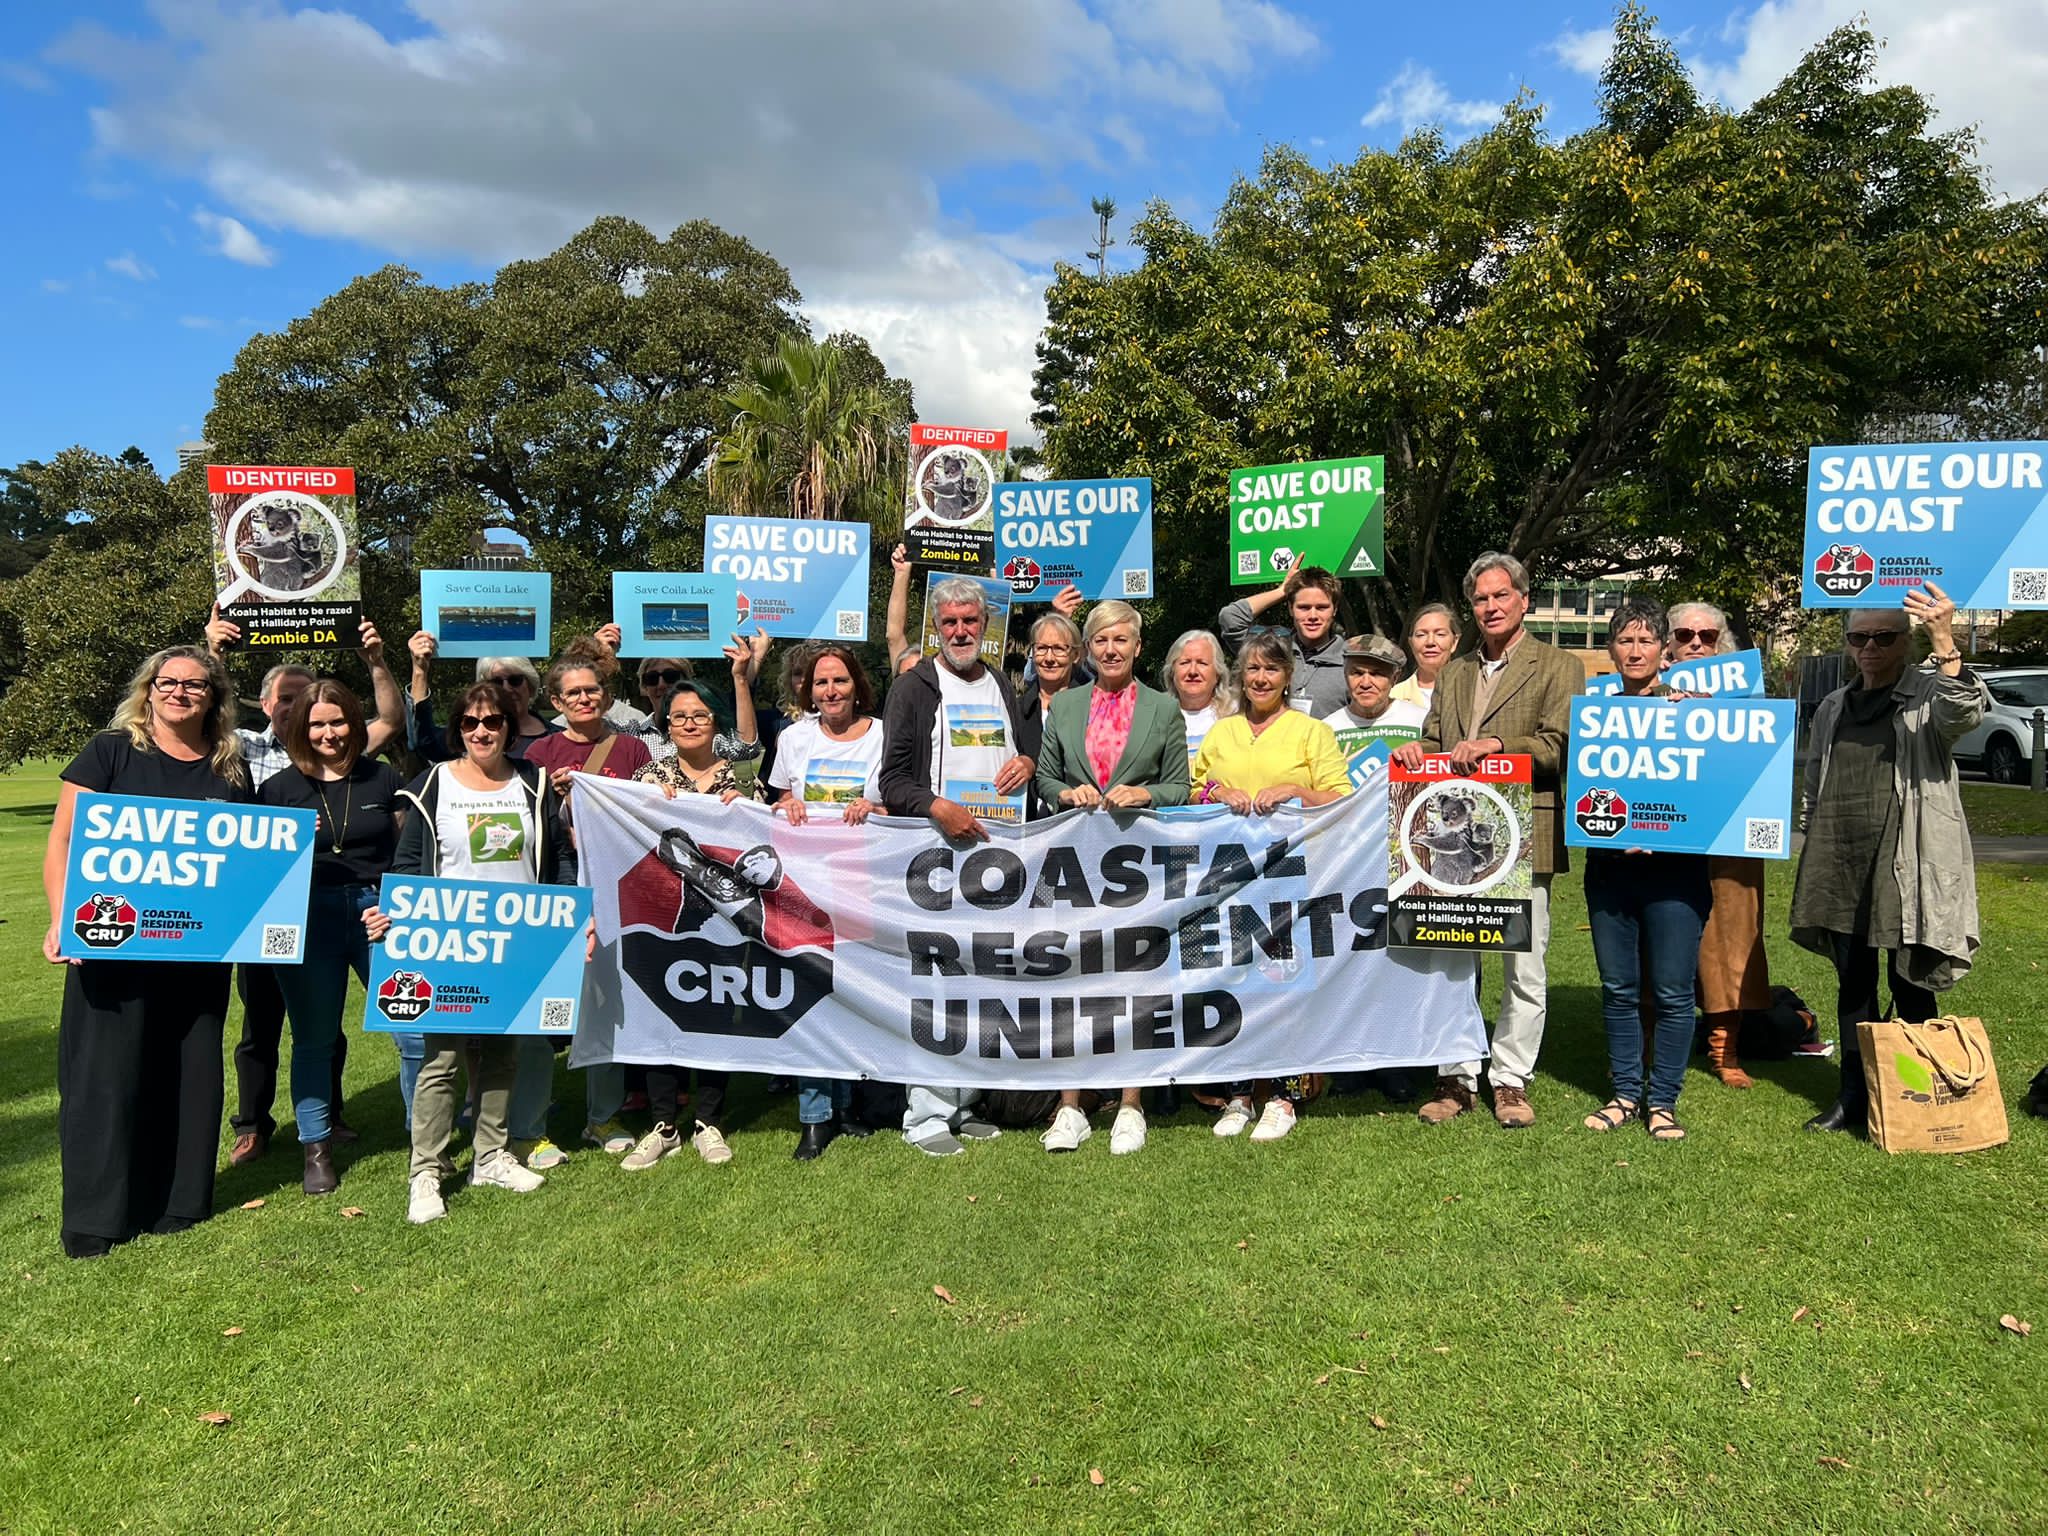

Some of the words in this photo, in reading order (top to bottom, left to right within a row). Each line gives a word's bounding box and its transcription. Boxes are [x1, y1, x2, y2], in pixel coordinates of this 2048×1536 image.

[922, 428, 996, 444] IDENTIFIED
[226, 470, 337, 486] IDENTIFIED
[1819, 455, 1932, 492] SAVE
[1941, 452, 2043, 489] OUR
[1238, 472, 1304, 503] SAVE
[1310, 466, 1372, 496] OUR
[999, 488, 1071, 517] SAVE
[1076, 486, 1140, 514] OUR
[1238, 502, 1324, 534] COAST
[1817, 497, 1963, 533] COAST
[712, 523, 786, 551] SAVE
[793, 528, 857, 555] OUR
[973, 534, 993, 542] razed
[1001, 520, 1091, 548] COAST
[931, 540, 960, 548] Hallidays
[961, 541, 980, 549] Point
[921, 549, 960, 560] Zombie
[962, 551, 980, 562] DA
[1879, 557, 1932, 566] COASTAL
[711, 554, 807, 583] COAST
[1043, 571, 1083, 579] RESIDENTS
[1879, 567, 1943, 576] RESIDENTS
[446, 583, 471, 594] Save
[474, 583, 501, 594] Coila
[505, 584, 529, 594] Lake
[1012, 580, 1034, 590] CRU
[1826, 577, 1862, 590] CRU
[1879, 577, 1923, 587] UNITED
[634, 585, 659, 595] Save
[661, 585, 688, 595] Coila
[691, 585, 715, 595] Lake
[753, 598, 787, 607] COASTAL
[229, 607, 257, 617] Koala
[261, 606, 296, 617] Habitat
[299, 606, 309, 616] to
[311, 606, 324, 616] be
[326, 606, 352, 615] razed
[753, 606, 795, 615] RESIDENTS
[249, 619, 260, 627] at
[261, 618, 307, 629] Hallidays
[310, 617, 335, 626] Point
[250, 631, 309, 645] Zombie
[314, 630, 337, 643] DA
[1670, 661, 1749, 695] OUR
[1579, 706, 1678, 740] SAVE
[1685, 708, 1776, 744] OUR
[1578, 745, 1705, 781] COAST
[987, 806, 1016, 818] VILLAGE
[1632, 802, 1677, 812] COASTAL
[1632, 812, 1687, 822] RESIDENTS
[84, 804, 199, 846] SAVE
[206, 813, 298, 851] OUR
[1585, 819, 1617, 832] CRU
[1632, 822, 1669, 831] UNITED
[80, 846, 226, 888] COAST
[905, 837, 1307, 911] COASTAL
[388, 885, 489, 924] SAVE
[495, 892, 576, 928] OUR
[1398, 900, 1427, 911] Koala
[1429, 901, 1464, 912] Habitat
[1466, 902, 1477, 912] to
[1479, 903, 1491, 913] be
[1494, 904, 1522, 914] razed
[142, 909, 192, 920] COASTAL
[1416, 914, 1426, 922] at
[1429, 914, 1474, 925] Hallidays
[1476, 915, 1503, 926] Point
[141, 919, 203, 931] RESIDENTS
[85, 929, 123, 941] CRU
[140, 930, 183, 940] UNITED
[905, 888, 1388, 978] RESIDENTS
[1415, 927, 1475, 942] Zombie
[1480, 930, 1505, 944] DA
[384, 925, 512, 964] COAST
[437, 984, 481, 995] COASTAL
[664, 959, 795, 1011] CRU
[436, 994, 490, 1005] RESIDENTS
[388, 1002, 421, 1015] CRU
[435, 1004, 472, 1014] UNITED
[910, 990, 1242, 1059] UNITED
